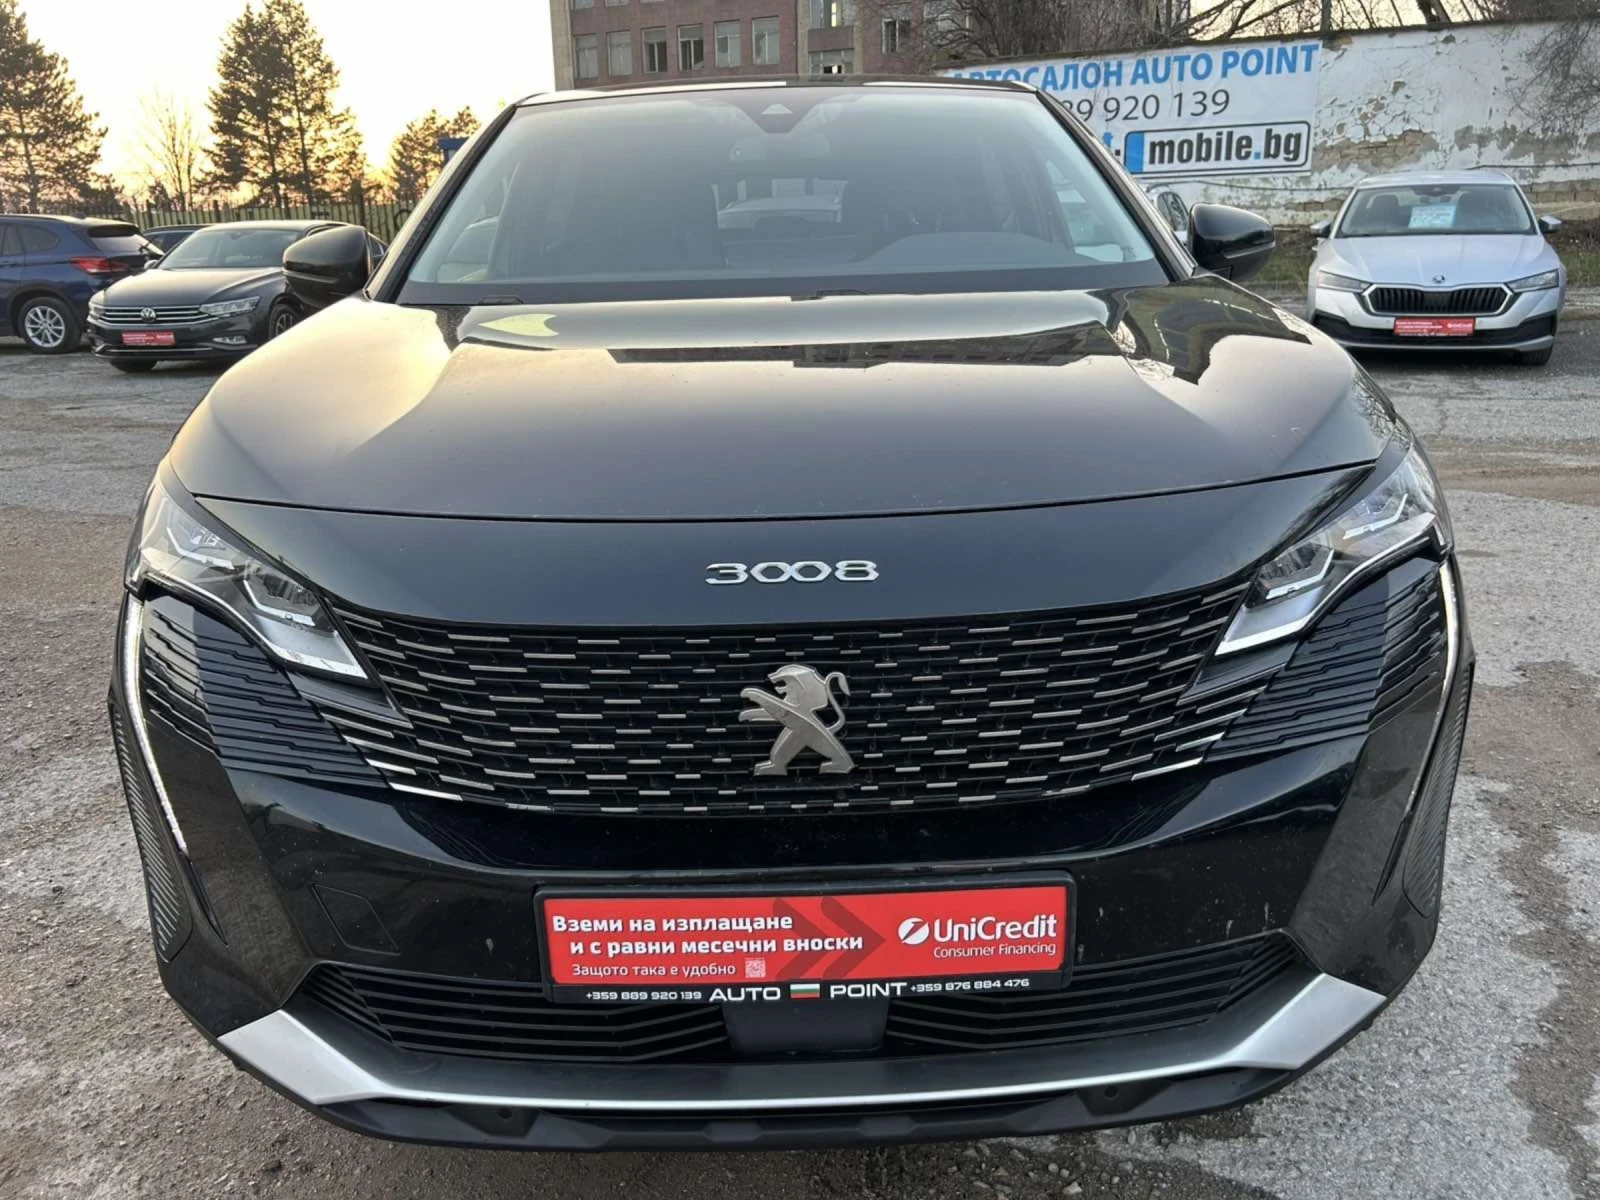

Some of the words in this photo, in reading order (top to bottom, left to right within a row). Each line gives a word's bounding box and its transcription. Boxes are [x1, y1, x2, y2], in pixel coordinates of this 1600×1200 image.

[955, 60, 1122, 91] ОСАЛОН
[1130, 54, 1213, 86] AUTO
[1221, 43, 1319, 79] POINT
[1103, 94, 1160, 122] 920
[1173, 89, 1230, 117] 139
[1148, 128, 1302, 165] mobile.bg
[705, 559, 879, 585] 3008
[552, 915, 623, 932] Вземи
[629, 918, 656, 932] на
[662, 916, 793, 932] изплащане
[933, 914, 1057, 943] UniCredit
[570, 941, 584, 955] и
[589, 941, 602, 955] с
[607, 940, 675, 958] равни
[681, 938, 777, 954] месечни
[783, 936, 863, 952] вноски
[933, 946, 994, 959] Consumer
[999, 943, 1056, 956] Financing
[572, 964, 628, 978] Защото
[632, 965, 666, 976] така
[670, 965, 679, 976] е
[684, 963, 736, 978] удобно
[585, 991, 618, 1000] +359
[620, 991, 648, 1000] 889
[650, 991, 678, 1000] 920
[681, 991, 702, 1000] 139
[709, 987, 781, 1002] AUTO
[829, 982, 908, 999] POINT
[910, 983, 942, 992] +359
[945, 982, 971, 991] 876
[974, 981, 1001, 990] 884
[1003, 978, 1030, 988] 476
